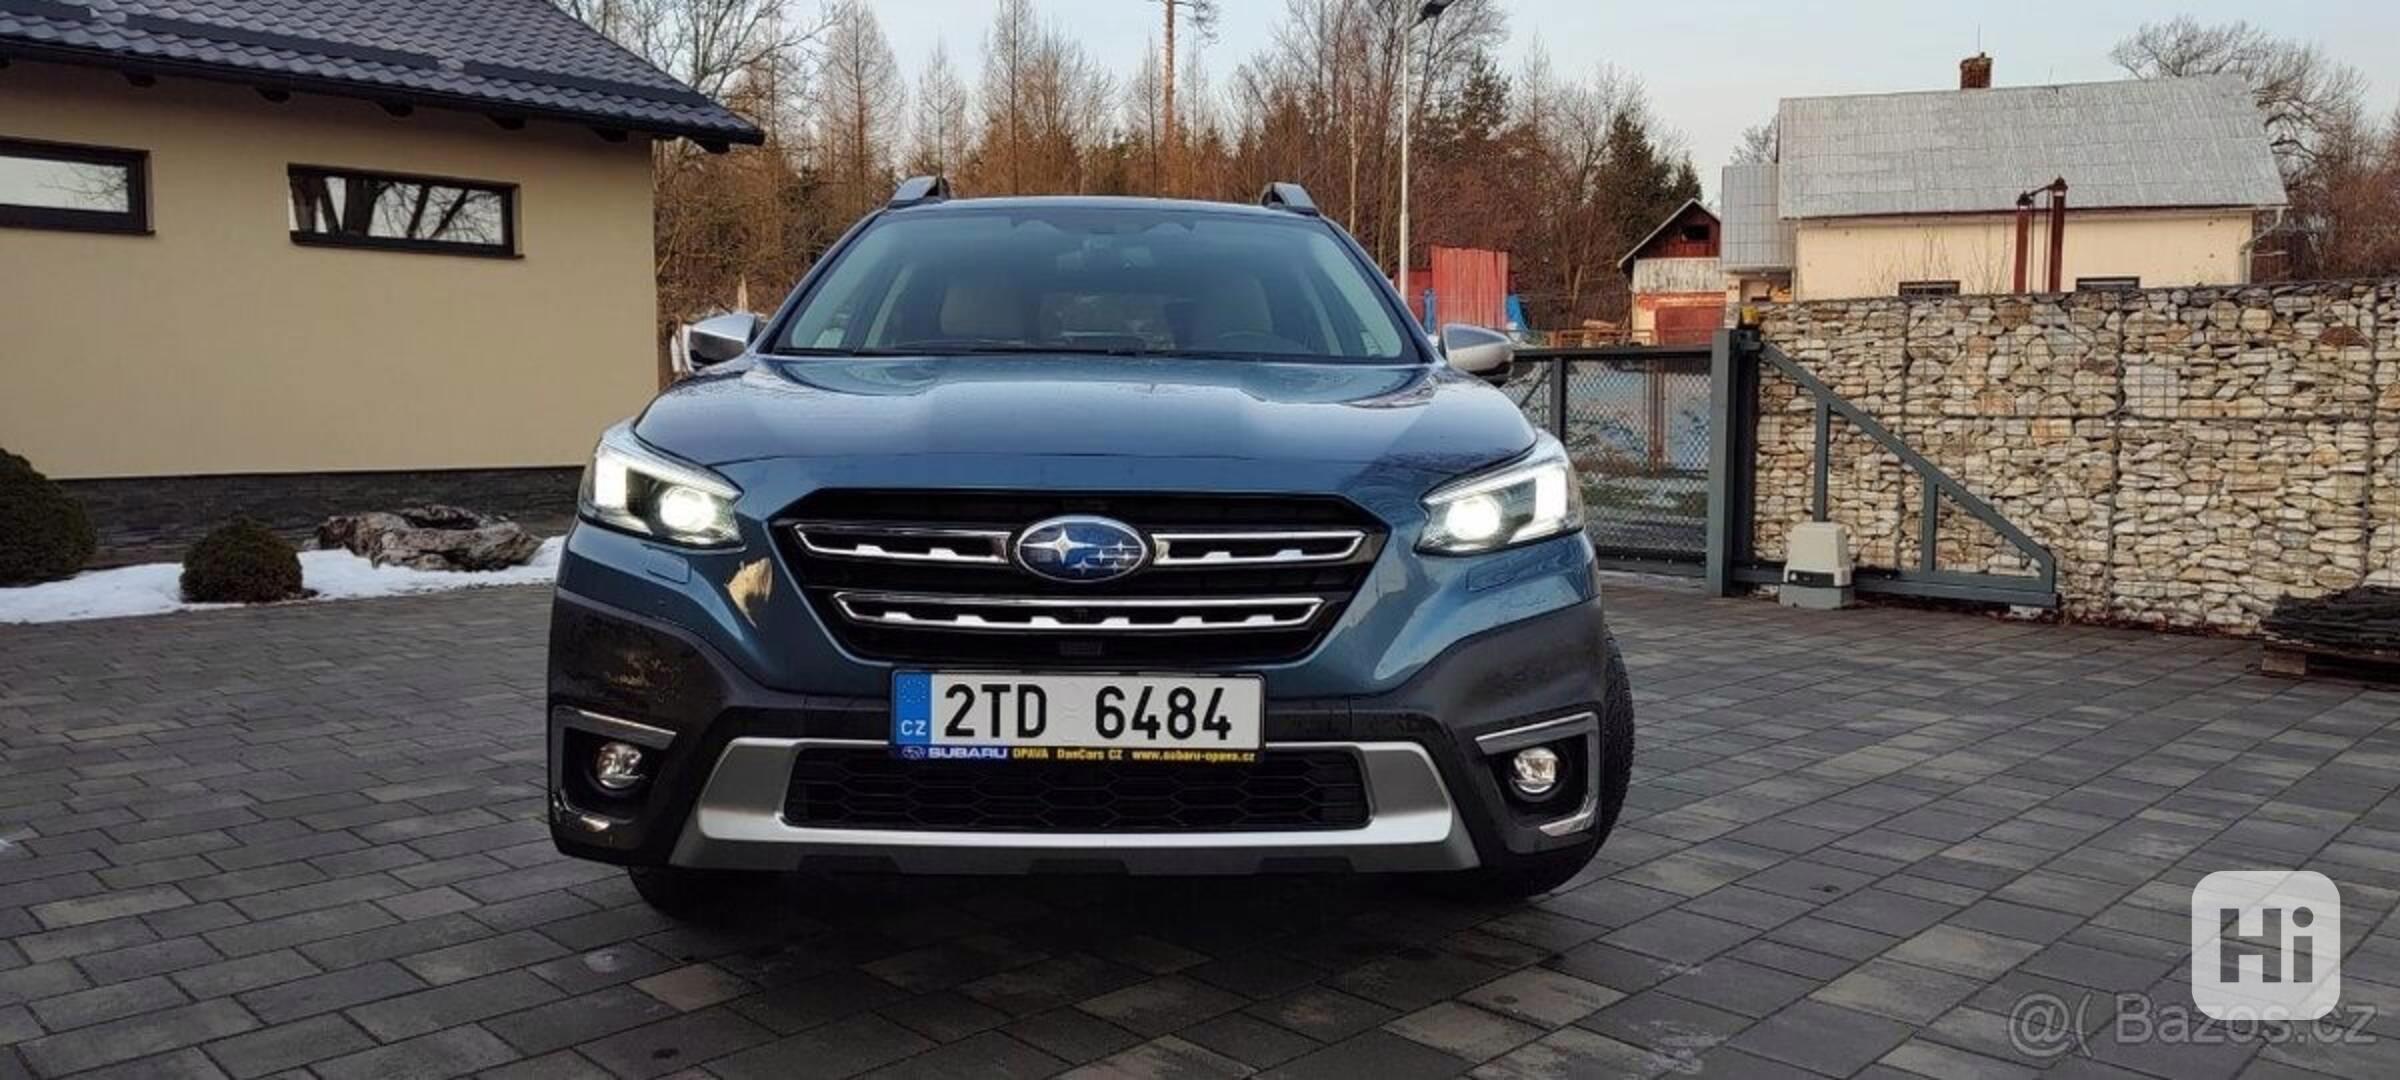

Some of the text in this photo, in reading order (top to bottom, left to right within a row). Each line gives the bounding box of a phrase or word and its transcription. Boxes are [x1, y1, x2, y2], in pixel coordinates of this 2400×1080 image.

[944, 683, 1232, 741] 2TD 6484
[900, 719, 927, 736] CZ
[928, 747, 1008, 760] SUBARU
[1012, 748, 1049, 760] OPAVA
[1132, 750, 1256, 764] www.subaru-opava.cz
